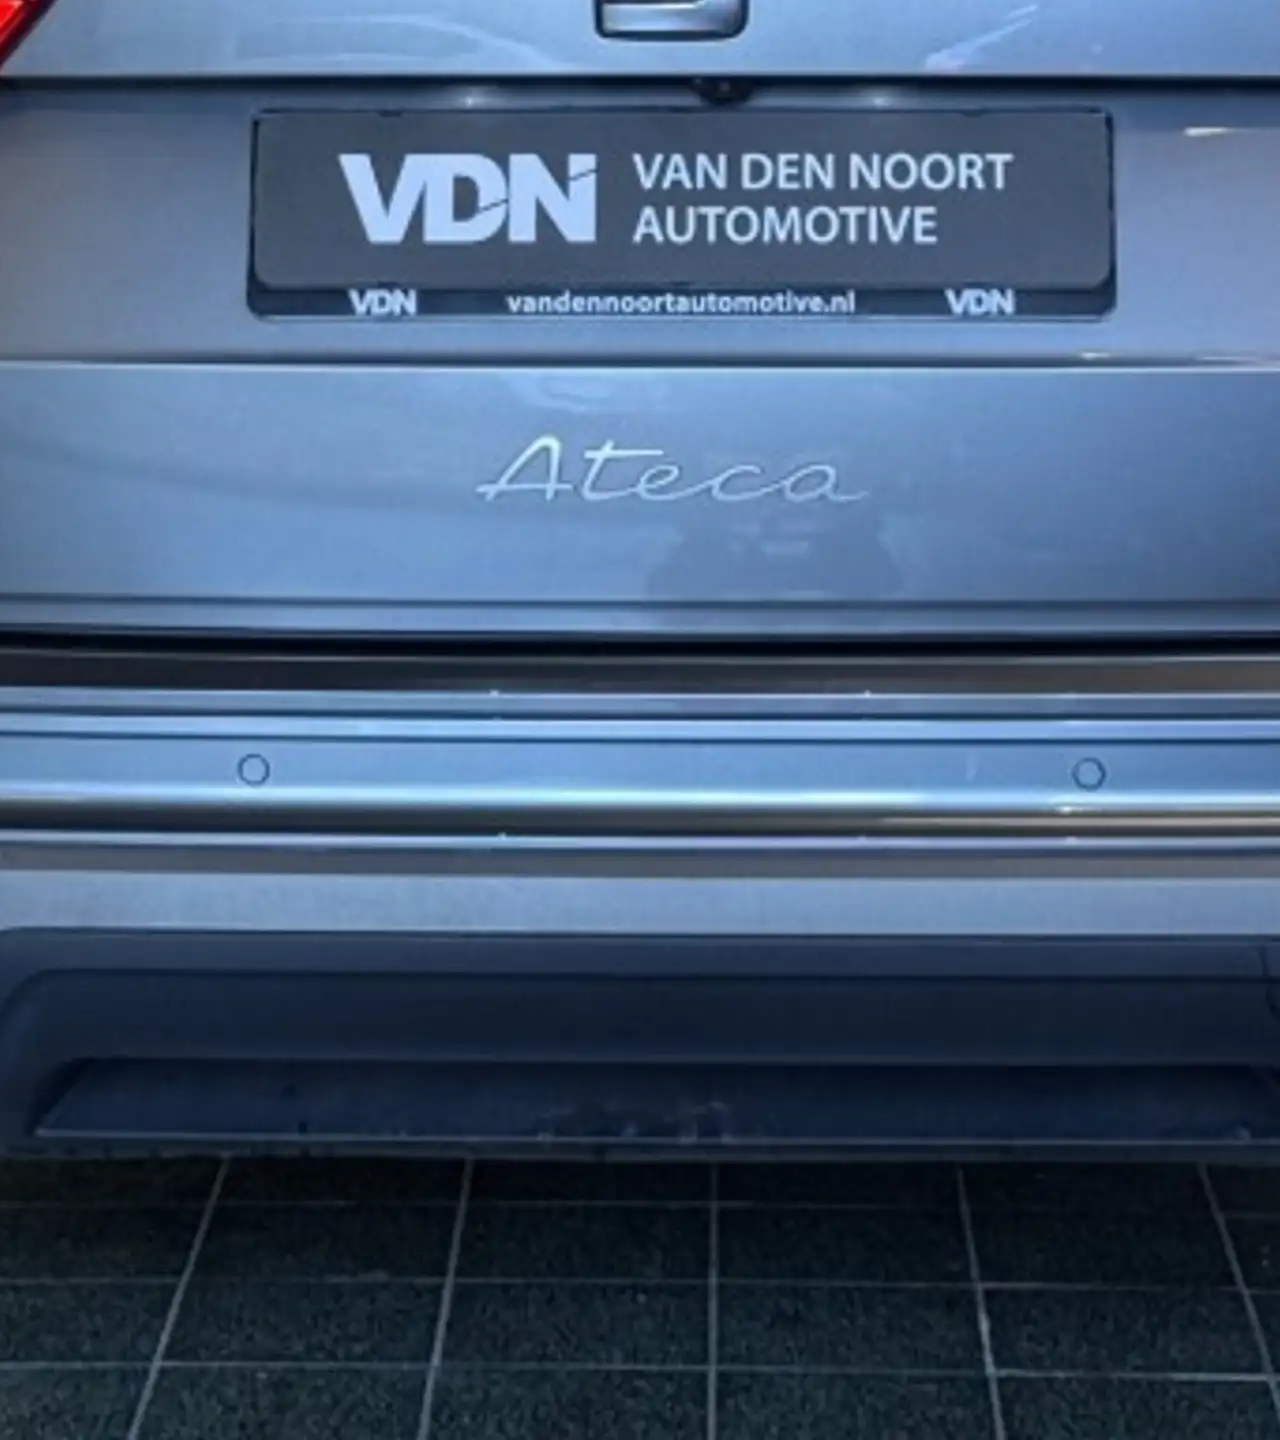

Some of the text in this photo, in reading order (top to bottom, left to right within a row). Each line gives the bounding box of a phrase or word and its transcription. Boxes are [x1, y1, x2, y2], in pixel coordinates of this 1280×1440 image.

[632, 152, 1014, 192] VAN DEN NOORT
[339, 153, 597, 245] VDN
[632, 205, 938, 246] AUTOMOTIVE
[349, 289, 417, 316] VDN
[507, 291, 856, 316] vandennoortautomotive.nl
[946, 289, 1015, 316] VDN
[476, 435, 869, 504] Ateca
